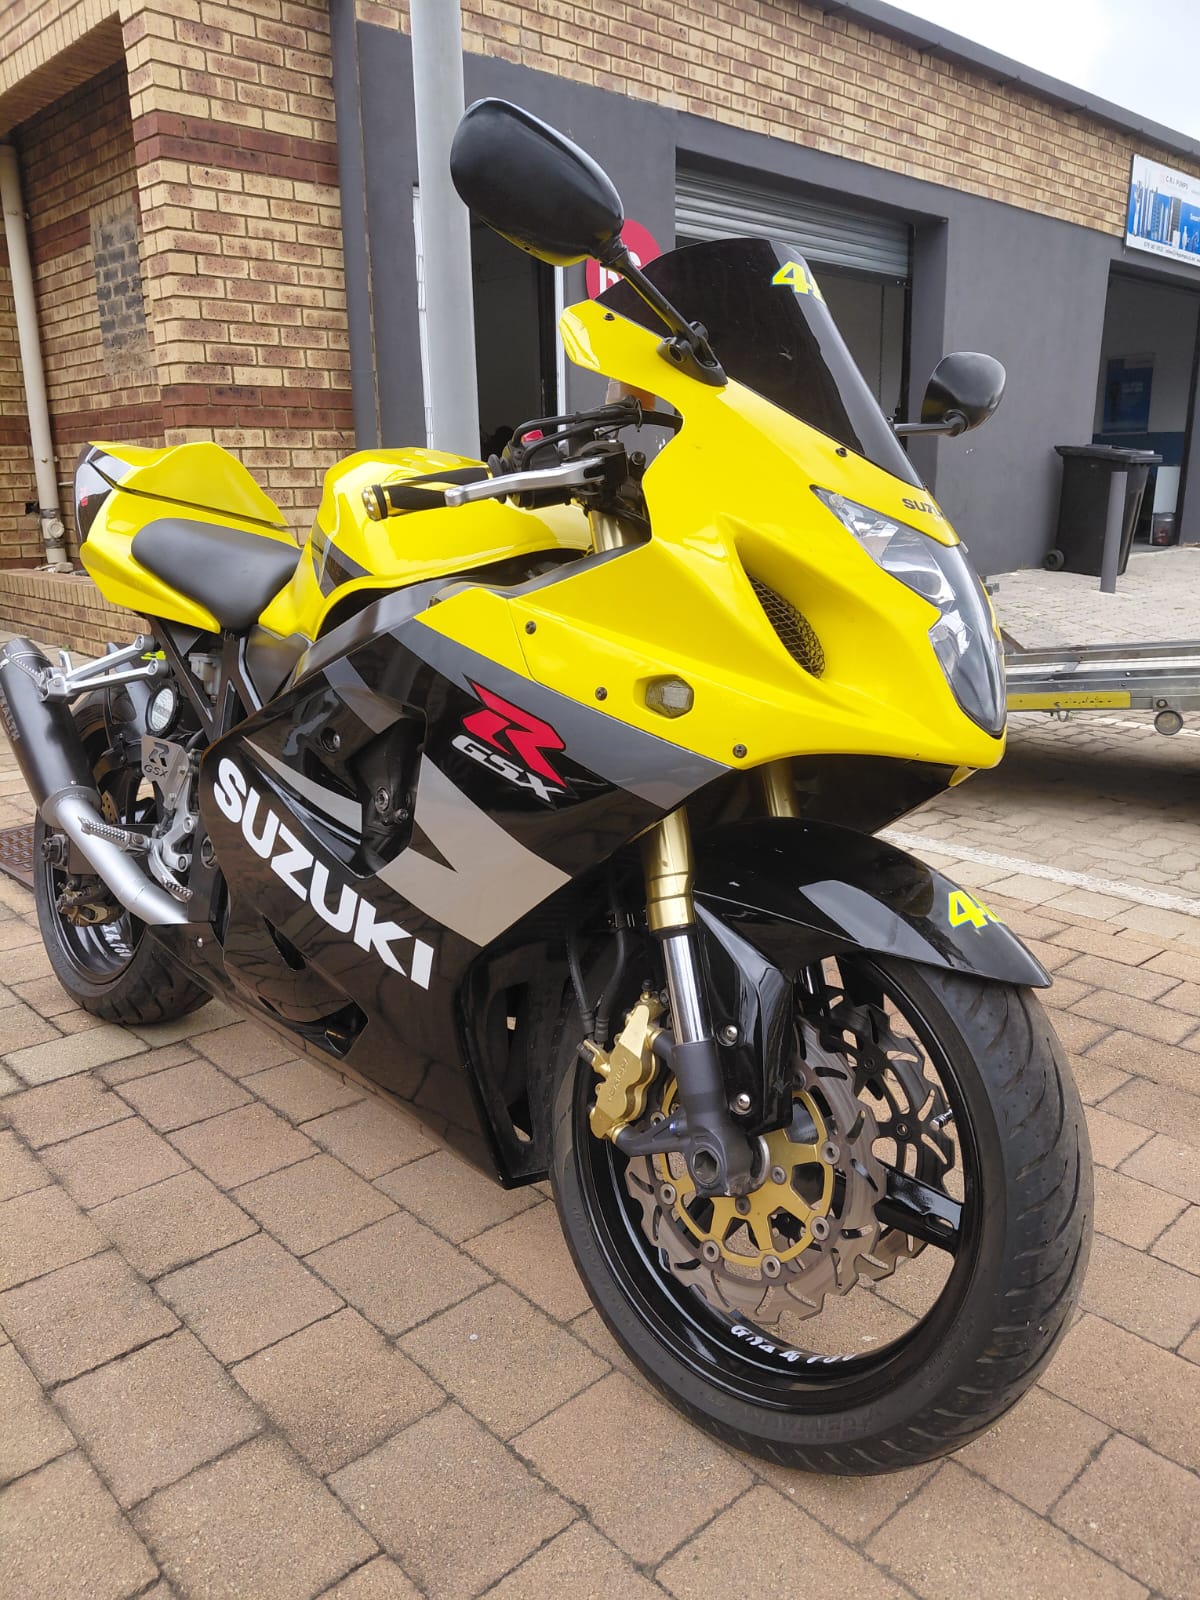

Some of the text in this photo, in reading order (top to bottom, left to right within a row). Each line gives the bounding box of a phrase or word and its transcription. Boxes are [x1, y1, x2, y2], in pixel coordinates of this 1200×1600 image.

[149, 741, 170, 767] R
[451, 734, 565, 802] GSX
[462, 680, 568, 789] R
[144, 764, 168, 779] GSX
[213, 757, 434, 990] SUZUKI
